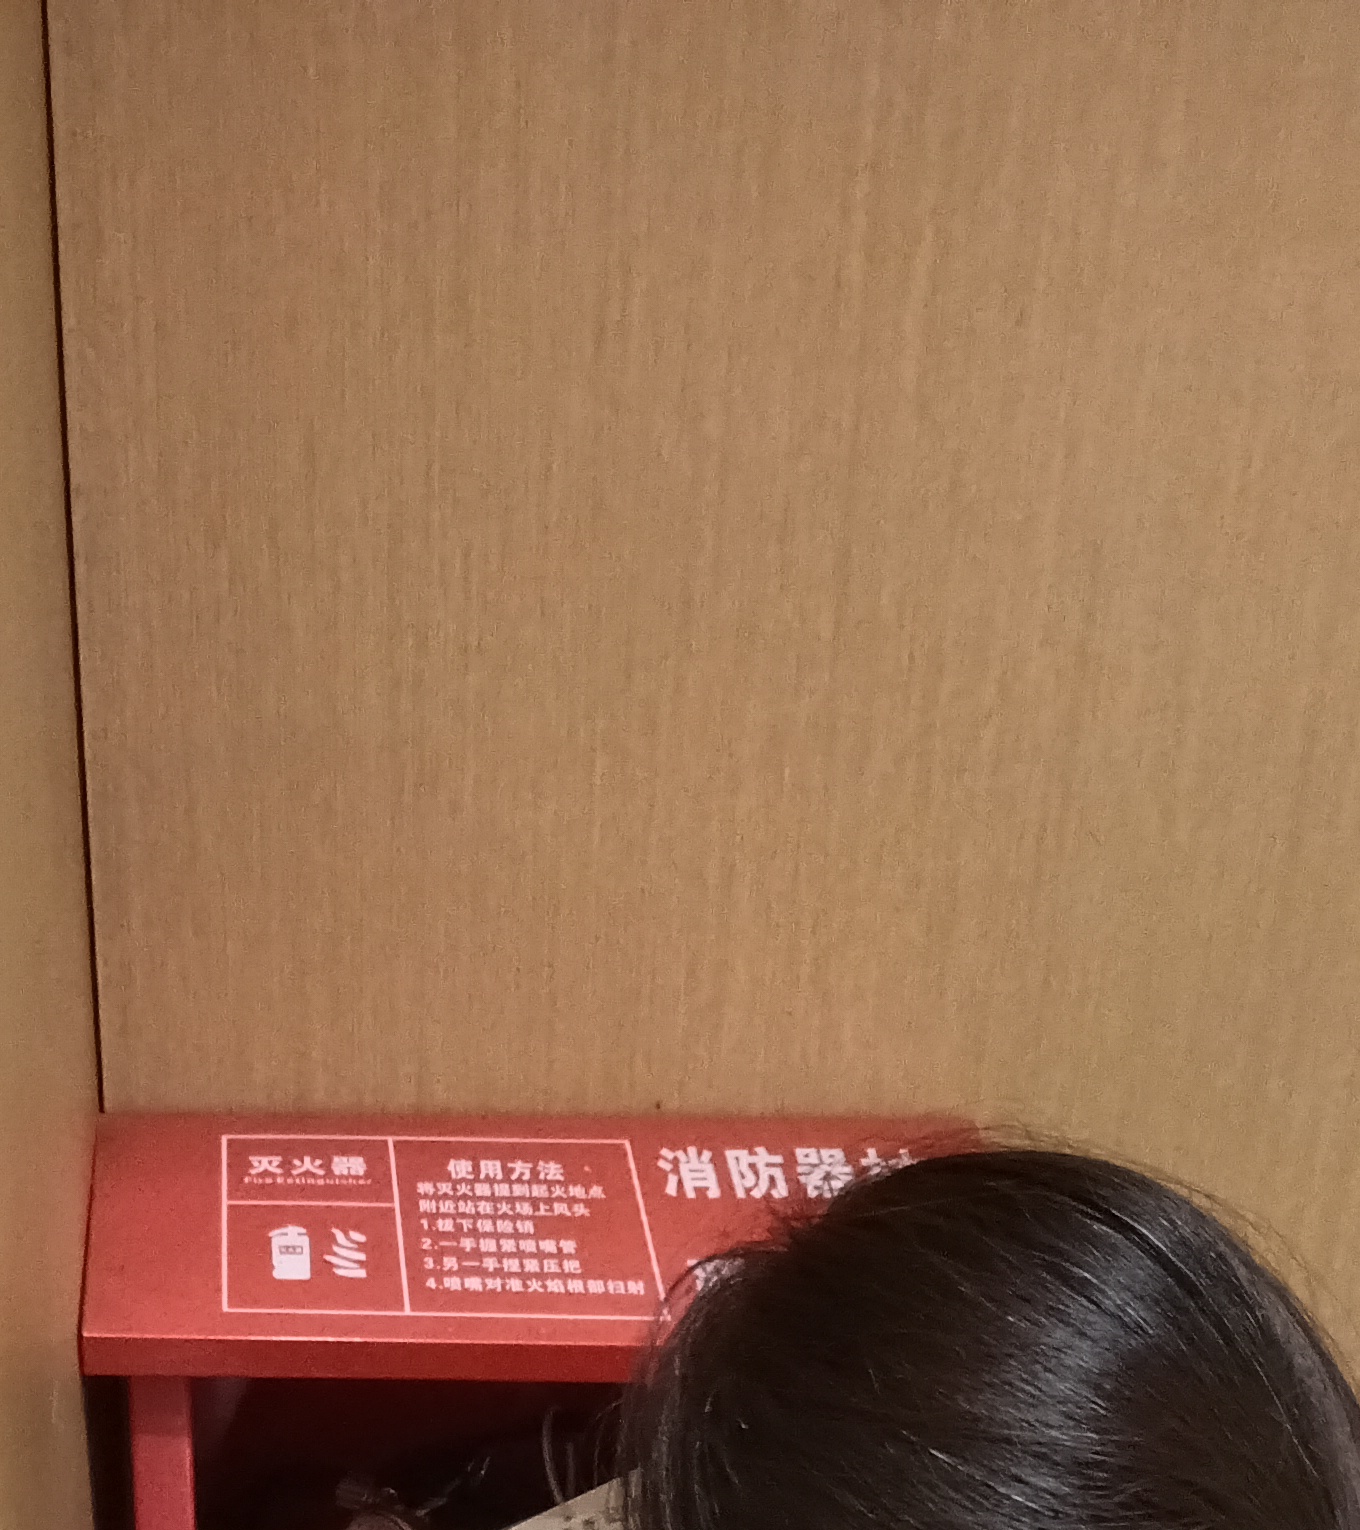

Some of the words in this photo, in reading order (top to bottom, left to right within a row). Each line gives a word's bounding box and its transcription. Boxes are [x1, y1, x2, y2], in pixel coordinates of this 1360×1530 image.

[248, 1155, 367, 1176] 灭火器
[447, 1158, 565, 1182] 使用方法
[419, 1199, 591, 1218] 附近站在火场上风头
[420, 1217, 535, 1235] 1.拔下保险销
